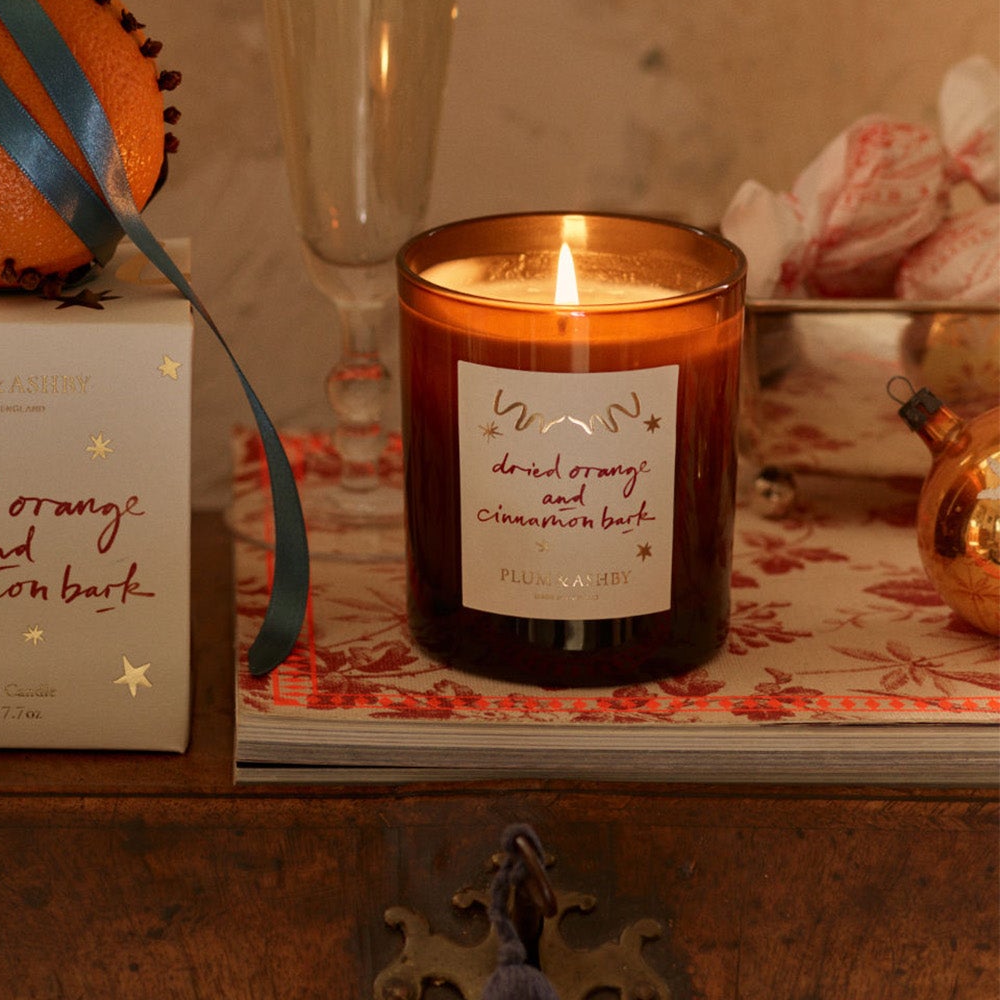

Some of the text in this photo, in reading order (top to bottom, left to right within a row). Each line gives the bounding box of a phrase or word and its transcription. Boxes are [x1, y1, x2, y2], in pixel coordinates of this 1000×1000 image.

[8, 374, 92, 394] ASHBY
[0, 404, 46, 413] ENGLAND
[491, 452, 652, 498] dried orange
[542, 483, 586, 512] and
[8, 495, 146, 554] orange
[476, 500, 656, 534] cinnamon bark
[60, 562, 156, 613] bark
[500, 568, 551, 587] PLUM
[572, 569, 632, 587] ASHBY
[4, 683, 58, 698] Candle
